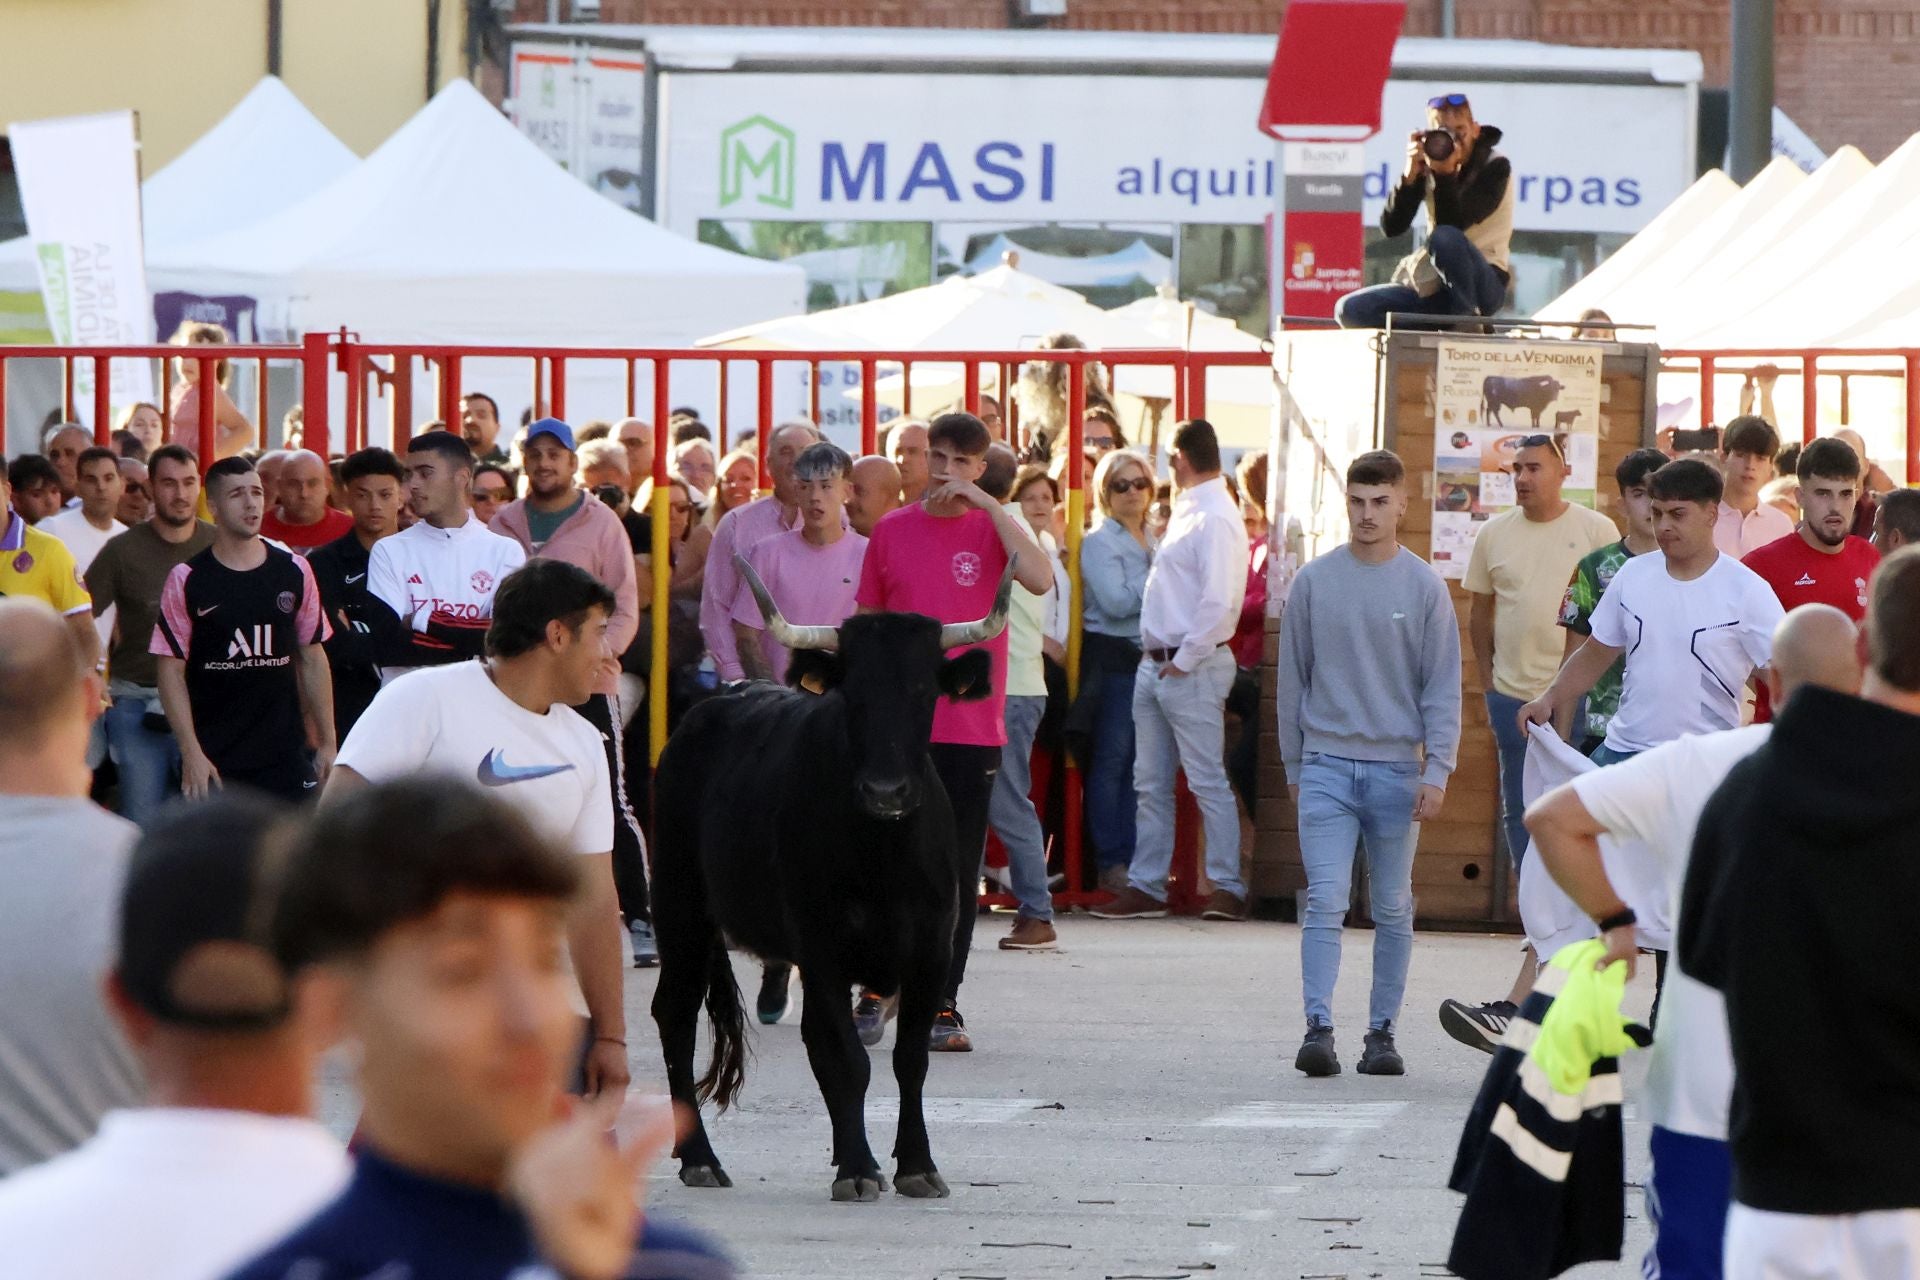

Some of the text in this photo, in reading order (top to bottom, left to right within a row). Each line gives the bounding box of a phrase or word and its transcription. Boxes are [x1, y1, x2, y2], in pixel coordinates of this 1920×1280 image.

[820, 141, 1054, 202] MASI
[1116, 158, 1642, 213] alquil d rpas
[431, 598, 480, 620] Tezo
[204, 661, 235, 670] ACCOR
